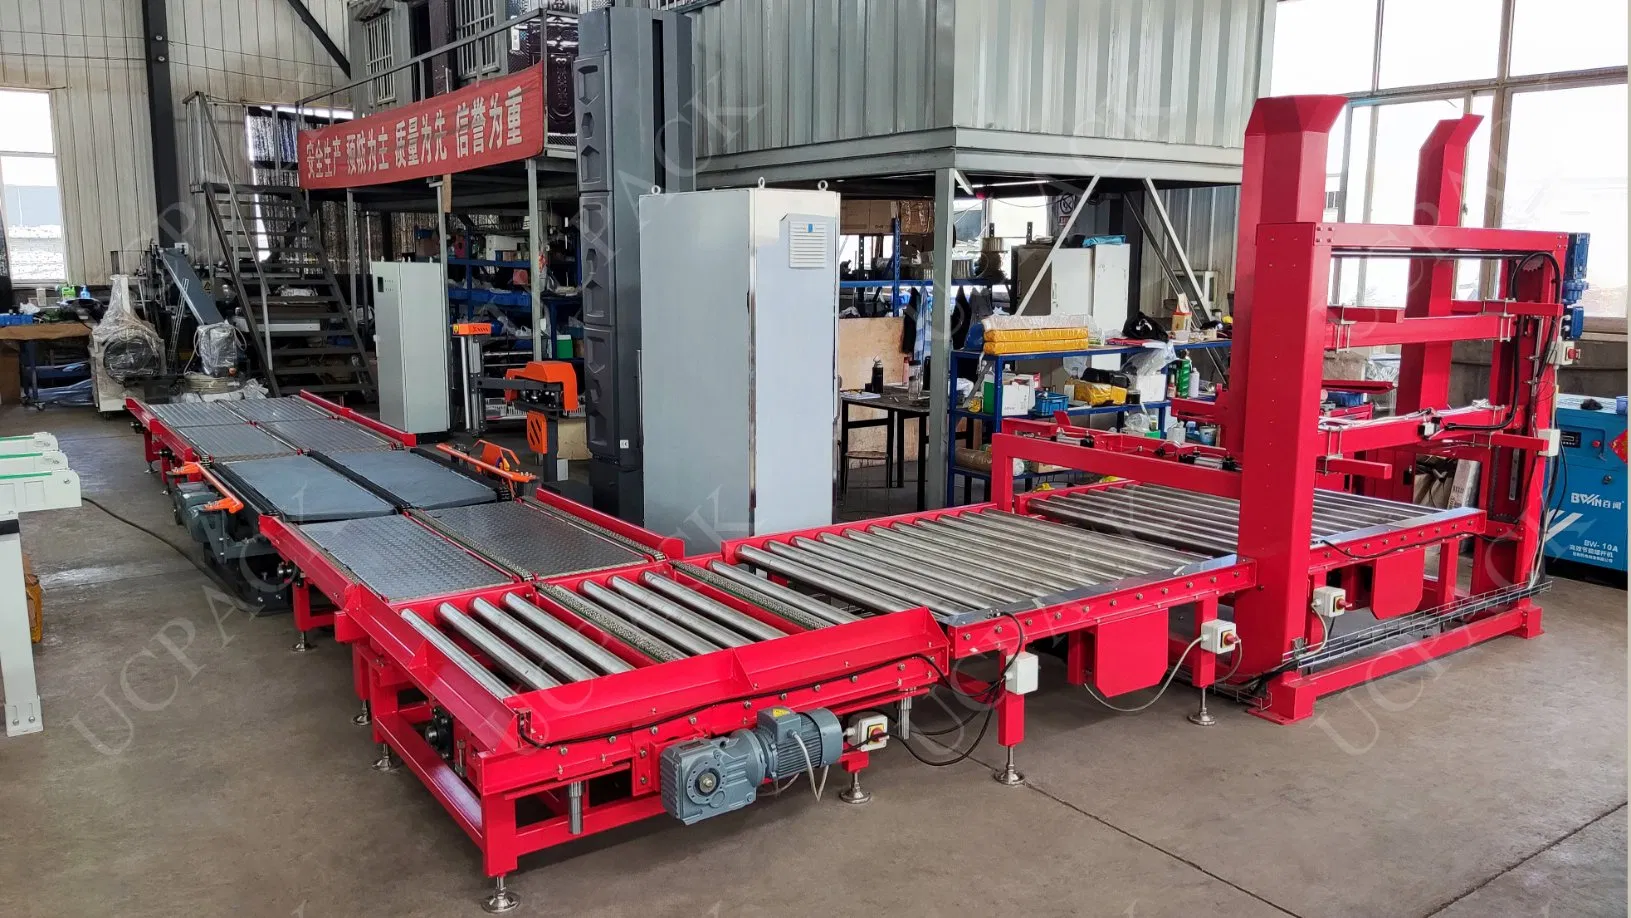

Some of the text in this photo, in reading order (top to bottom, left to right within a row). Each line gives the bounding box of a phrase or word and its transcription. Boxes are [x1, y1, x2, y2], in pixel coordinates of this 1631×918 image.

[306, 86, 523, 179] 安全生产 预防为主 质量为先 信誉为重
